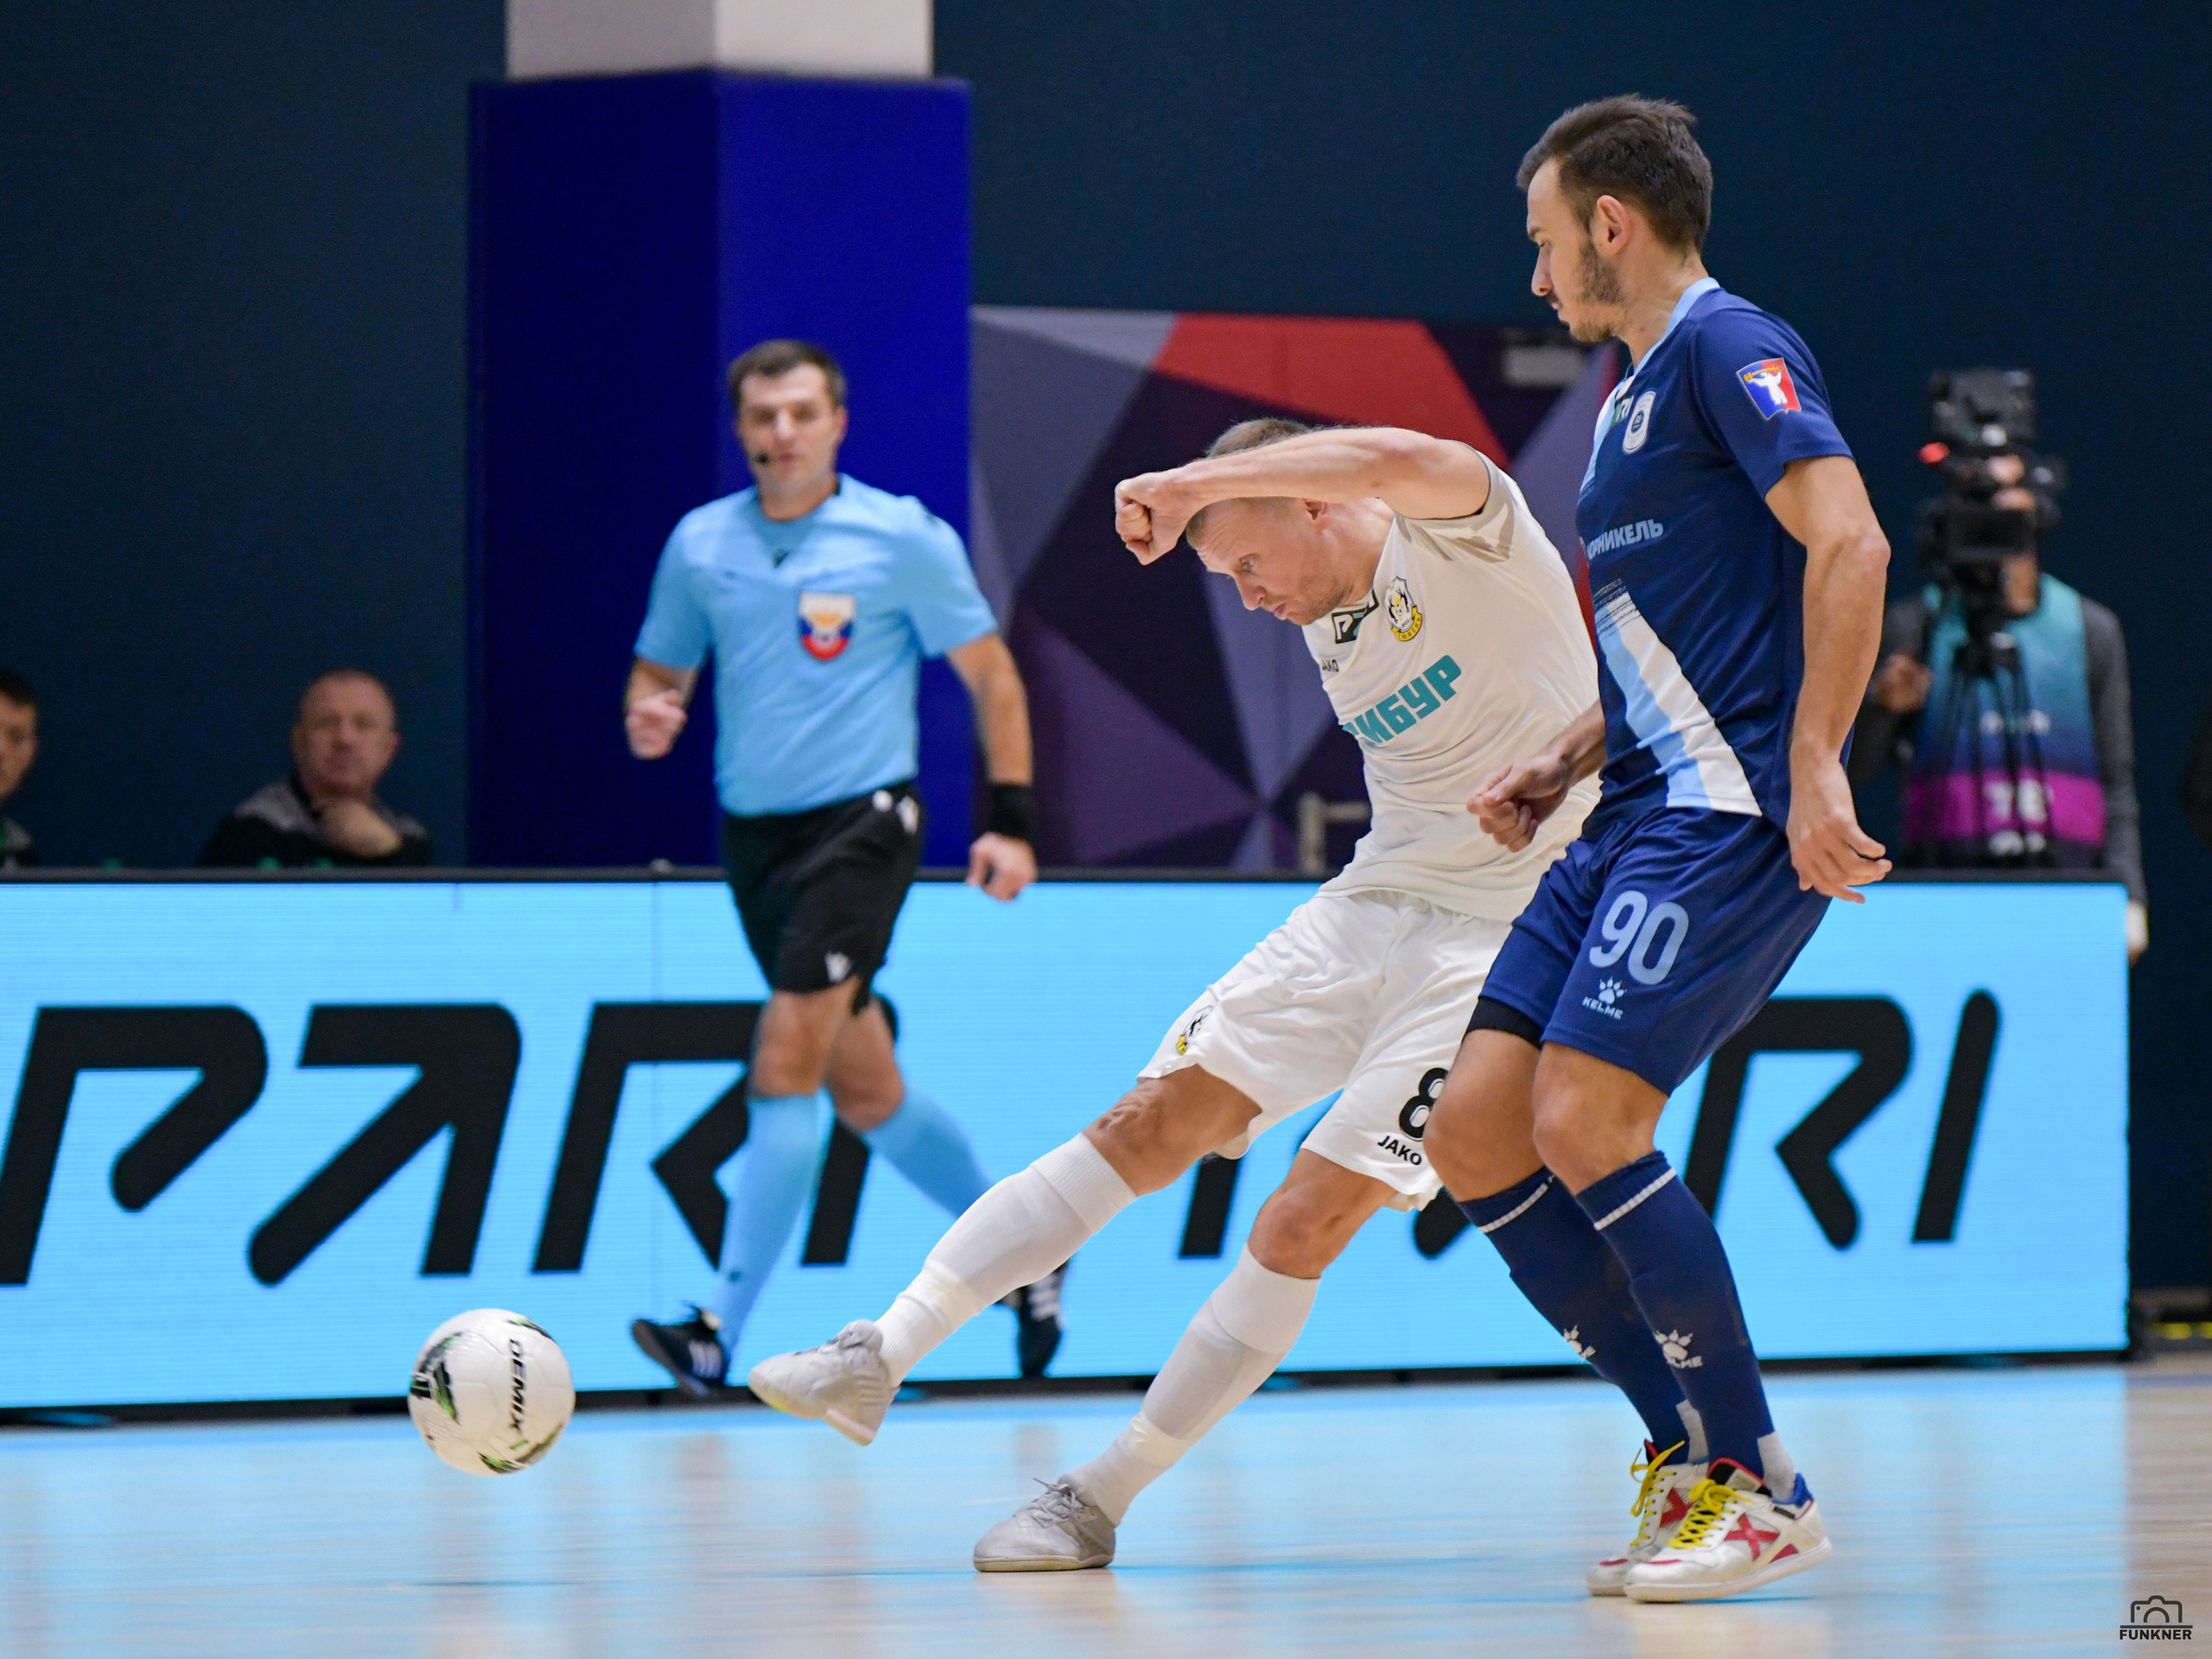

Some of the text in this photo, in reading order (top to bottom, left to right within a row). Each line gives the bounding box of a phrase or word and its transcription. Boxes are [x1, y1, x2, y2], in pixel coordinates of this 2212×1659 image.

[1586, 518, 1664, 560] ОРНИКЕЛЬ
[1589, 890, 1689, 986] 90
[1581, 995, 1624, 1020] KELME
[1179, 988, 2003, 1258] RI
[1398, 1067, 1449, 1142] 8
[1376, 1135, 1423, 1166] JAKO
[508, 1338, 528, 1433] DEMIX
